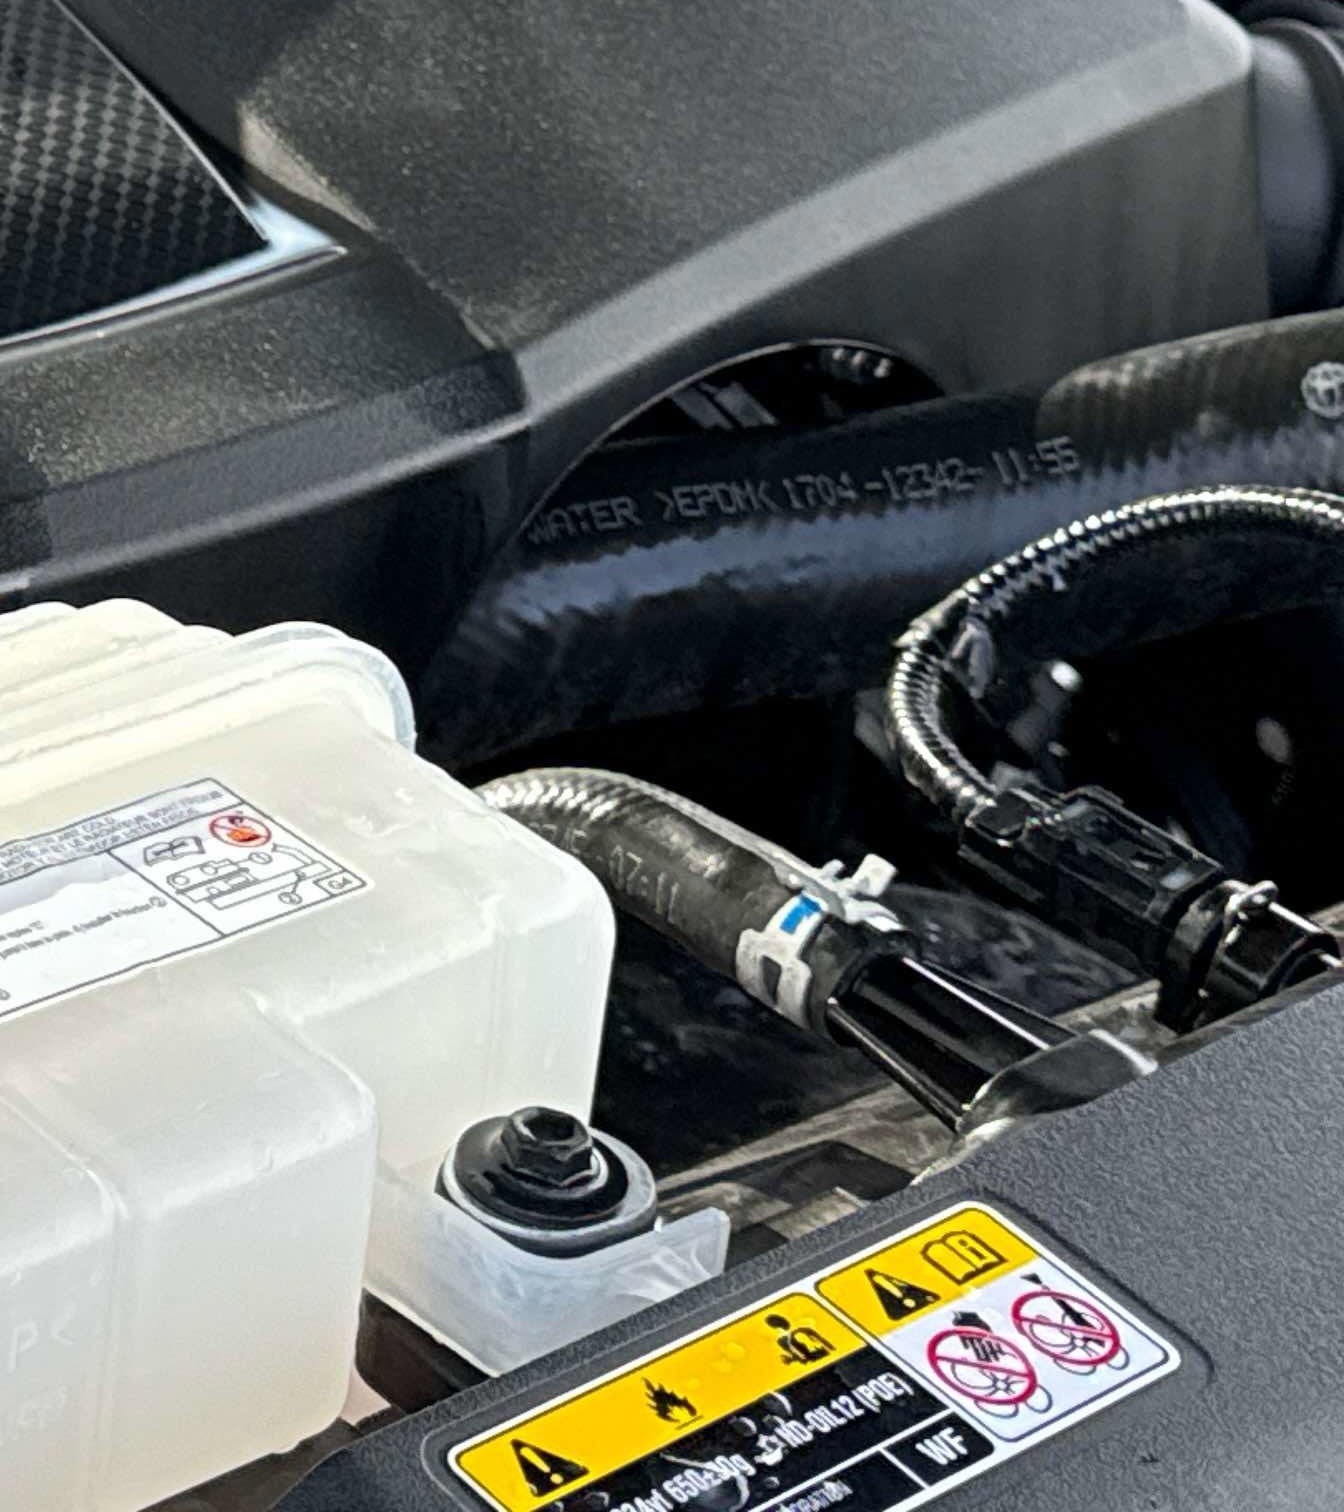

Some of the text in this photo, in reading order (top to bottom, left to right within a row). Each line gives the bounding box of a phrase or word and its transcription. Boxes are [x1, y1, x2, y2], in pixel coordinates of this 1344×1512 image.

[528, 496, 642, 544] WATER
[774, 1394, 866, 1449] ND-OIL12
[851, 1371, 916, 1414] (POE)
[914, 1425, 969, 1467] WF
